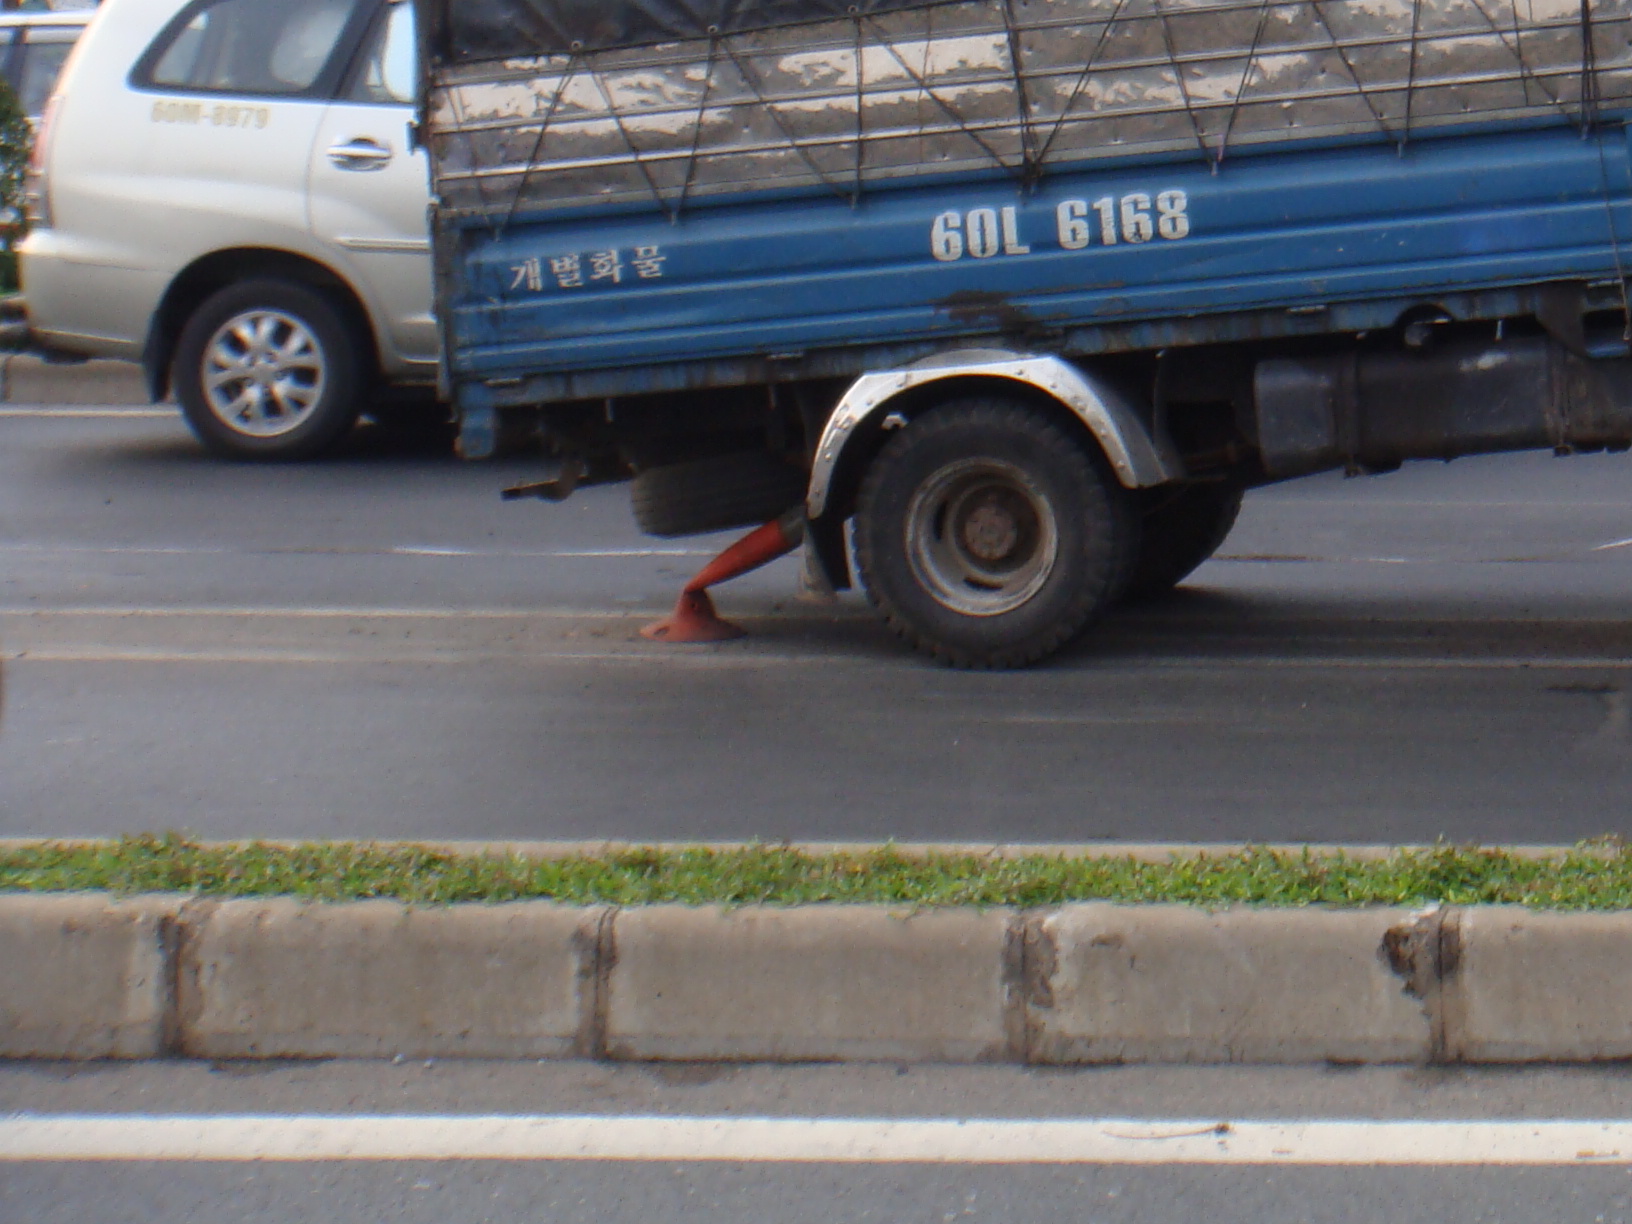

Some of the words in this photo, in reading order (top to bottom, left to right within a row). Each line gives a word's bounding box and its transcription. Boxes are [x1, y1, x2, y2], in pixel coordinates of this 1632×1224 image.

[930, 206, 1031, 262] 60L
[1056, 189, 1190, 250] 6168
[510, 245, 667, 292] 개별화물
